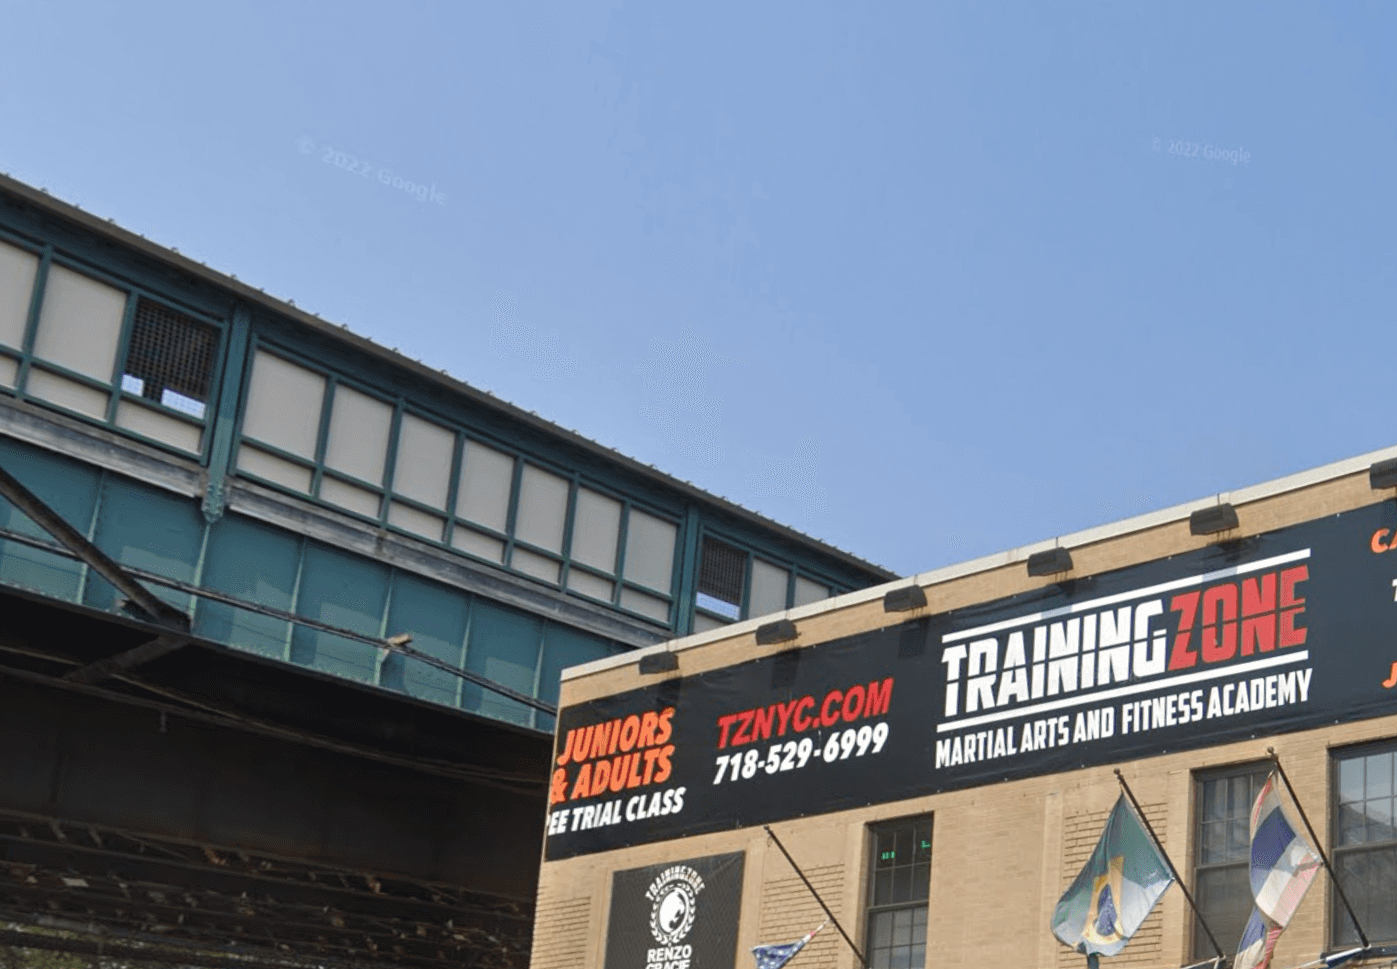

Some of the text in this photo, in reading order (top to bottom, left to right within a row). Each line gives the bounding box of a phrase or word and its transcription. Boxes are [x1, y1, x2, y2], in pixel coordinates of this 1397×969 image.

[556, 707, 676, 766] JUNIORS
[716, 677, 894, 749] TZNYC.COM
[936, 668, 1313, 769] MARTIAL ARTS AND FITNESS ACADEMY
[550, 744, 676, 805] & ADULTS
[713, 722, 890, 785] 718-529-6999
[547, 787, 687, 836] EE TRIAL CLASS
[647, 944, 692, 963] RENZO
